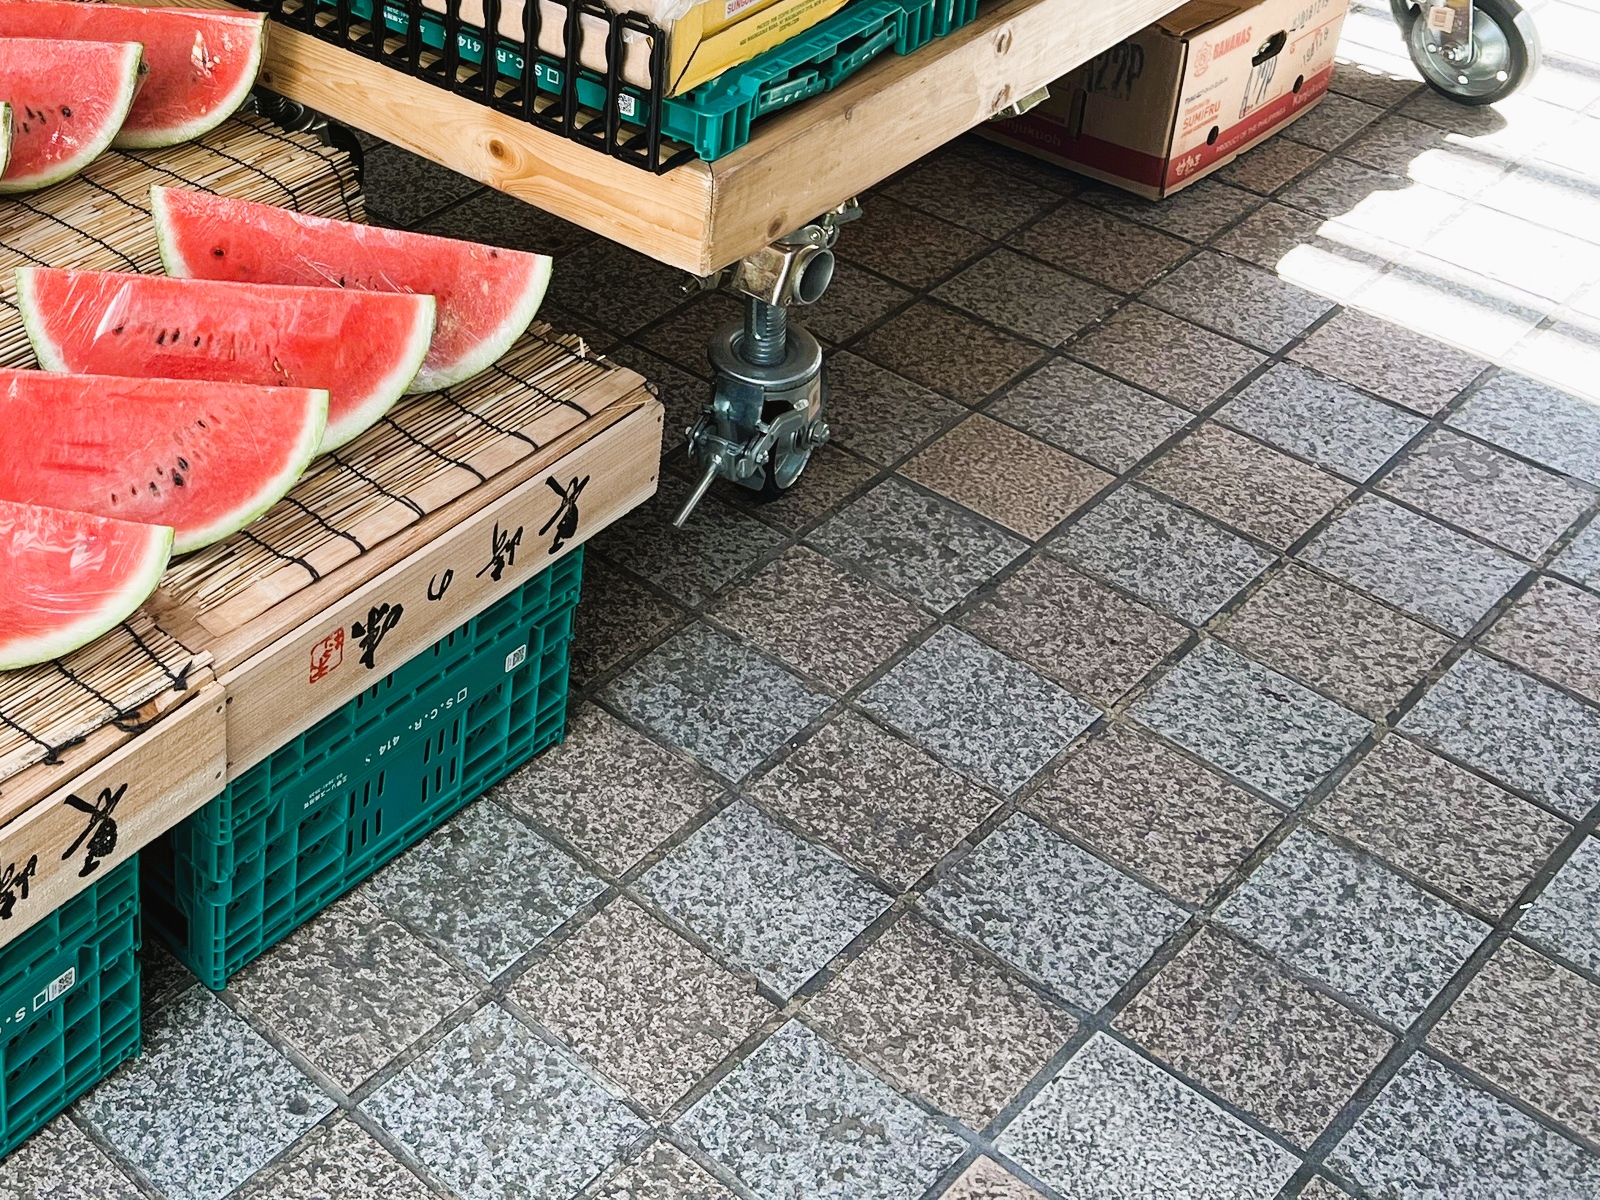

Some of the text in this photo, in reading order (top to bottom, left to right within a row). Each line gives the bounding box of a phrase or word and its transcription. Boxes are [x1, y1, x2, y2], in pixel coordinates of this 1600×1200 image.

[1212, 25, 1253, 61] BANANAS
[1182, 101, 1222, 131] SUMIFRU
[378, 733, 401, 758] 414
